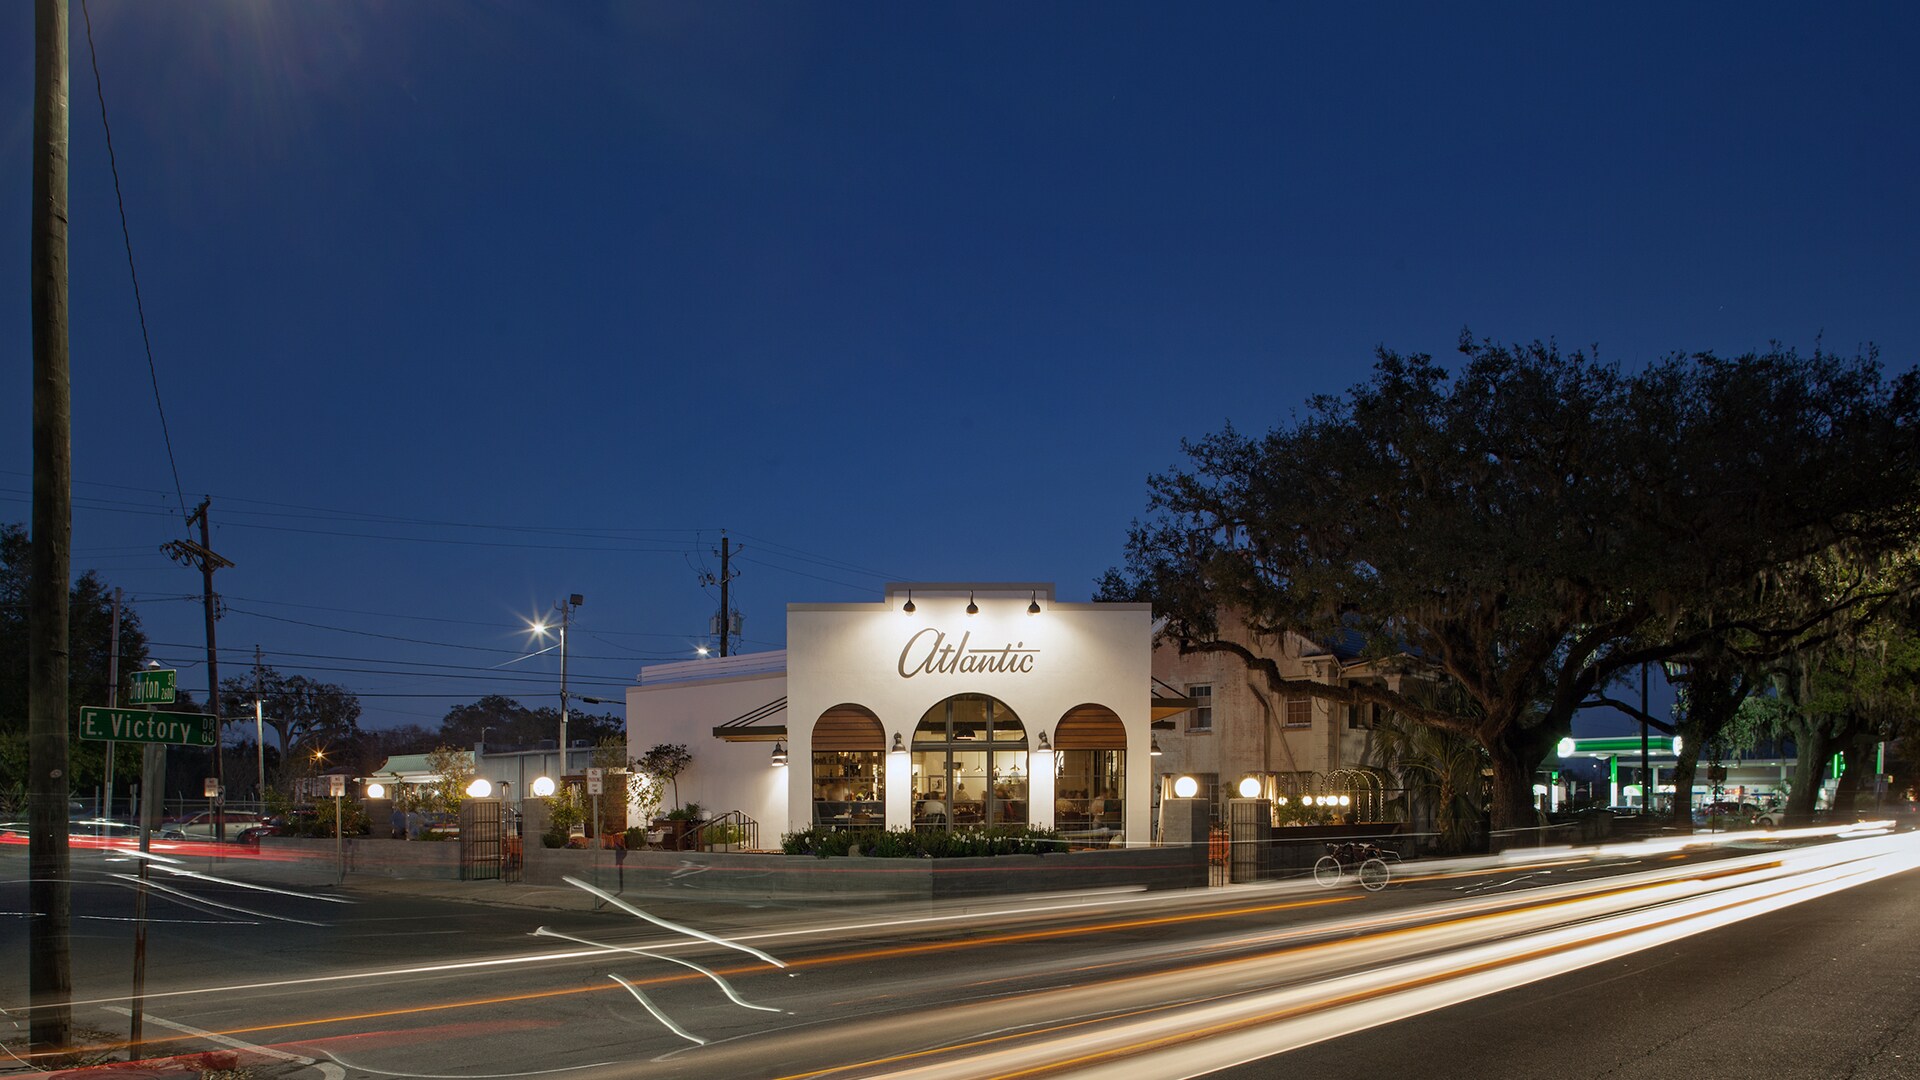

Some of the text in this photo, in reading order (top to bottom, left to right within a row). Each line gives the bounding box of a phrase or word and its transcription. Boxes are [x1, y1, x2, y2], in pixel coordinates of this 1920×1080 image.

[898, 627, 1040, 678] Atlantic
[130, 677, 160, 703] Drayton
[86, 712, 103, 736] E.
[111, 713, 191, 744] Victory
